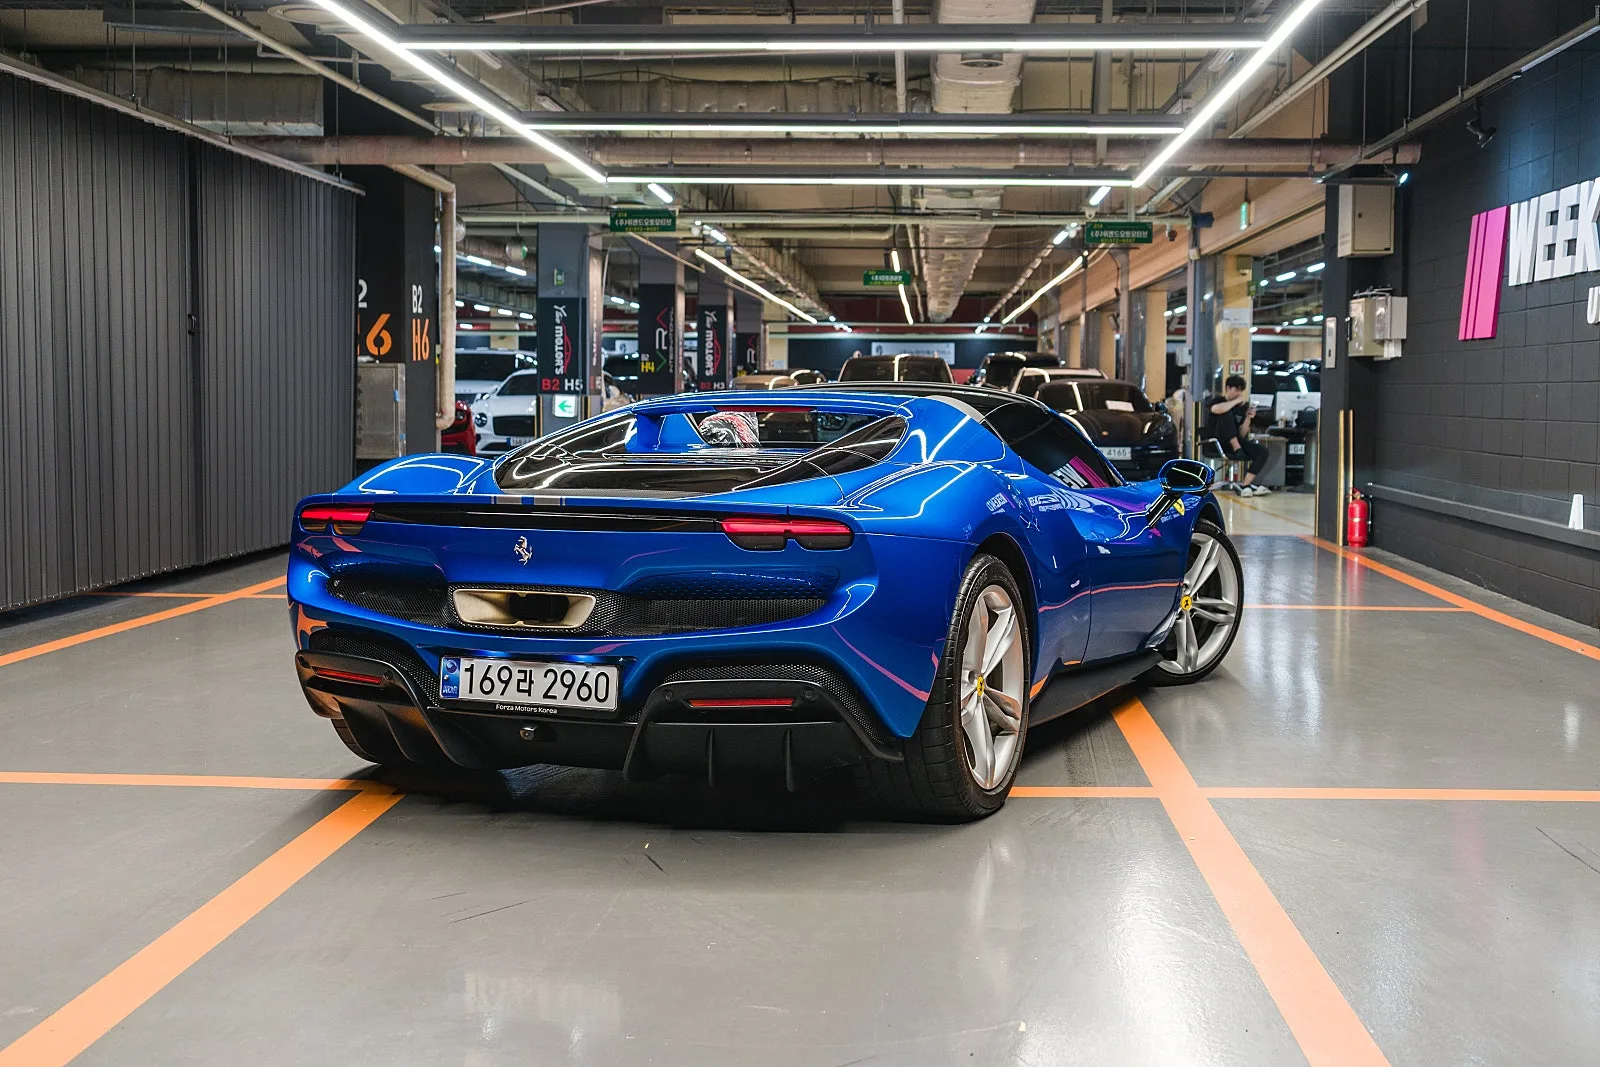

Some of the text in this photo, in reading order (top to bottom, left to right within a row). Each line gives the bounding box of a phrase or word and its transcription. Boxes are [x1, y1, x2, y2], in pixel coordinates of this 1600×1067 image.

[412, 284, 423, 313] B2
[1587, 286, 1600, 325] U
[357, 313, 392, 356] 6
[412, 318, 430, 361] H6
[641, 361, 656, 373] H4
[541, 378, 560, 391] B2
[564, 378, 583, 391] H5
[713, 381, 725, 389] H3
[1107, 449, 1127, 457] 4165
[464, 663, 610, 703] 169라 2960
[495, 703, 514, 711] Forza
[514, 705, 537, 713] Motors
